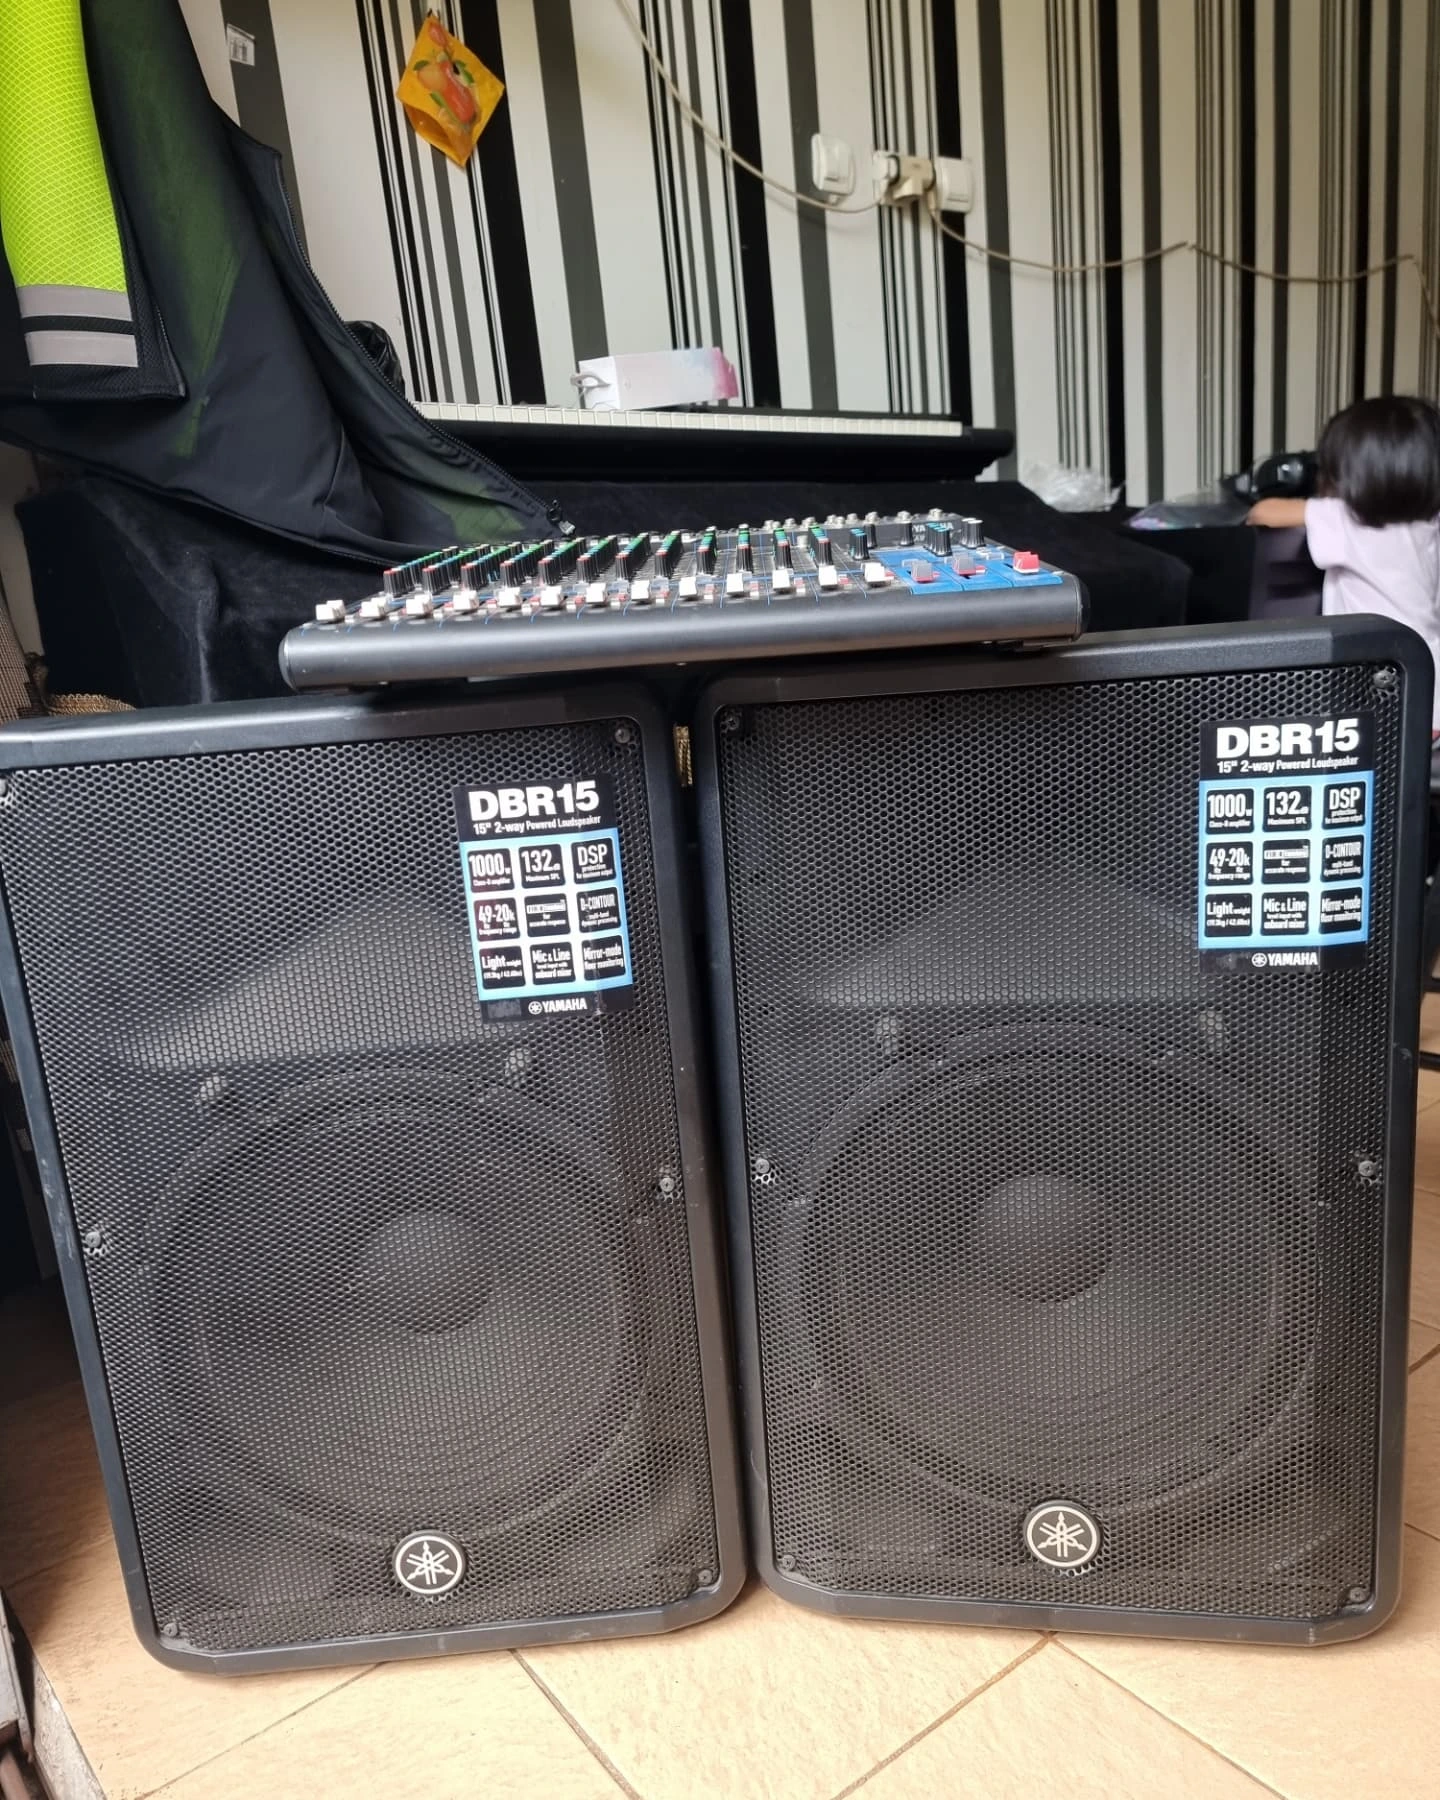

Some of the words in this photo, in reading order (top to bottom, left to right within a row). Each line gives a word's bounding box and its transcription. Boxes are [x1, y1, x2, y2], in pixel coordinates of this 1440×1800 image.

[1216, 718, 1359, 759] DBR15
[1217, 760, 1238, 774] 15"
[1240, 760, 1275, 773] 2-way
[1276, 758, 1311, 770] Powered
[1312, 755, 1359, 770] Loudspeaker
[468, 780, 600, 821] DBR15
[1329, 786, 1361, 810] DSP
[473, 822, 491, 835] 15"
[494, 821, 525, 834] 2-way
[526, 818, 557, 830] Powered
[558, 815, 601, 828] Loudspeaker
[577, 843, 607, 866] DSP
[1264, 898, 1280, 912] Mic
[1286, 897, 1307, 912] Line
[532, 949, 547, 963] Mic
[553, 948, 571, 961] Line
[1268, 952, 1318, 966] YAMAHA
[542, 997, 588, 1013] YAMAHA
